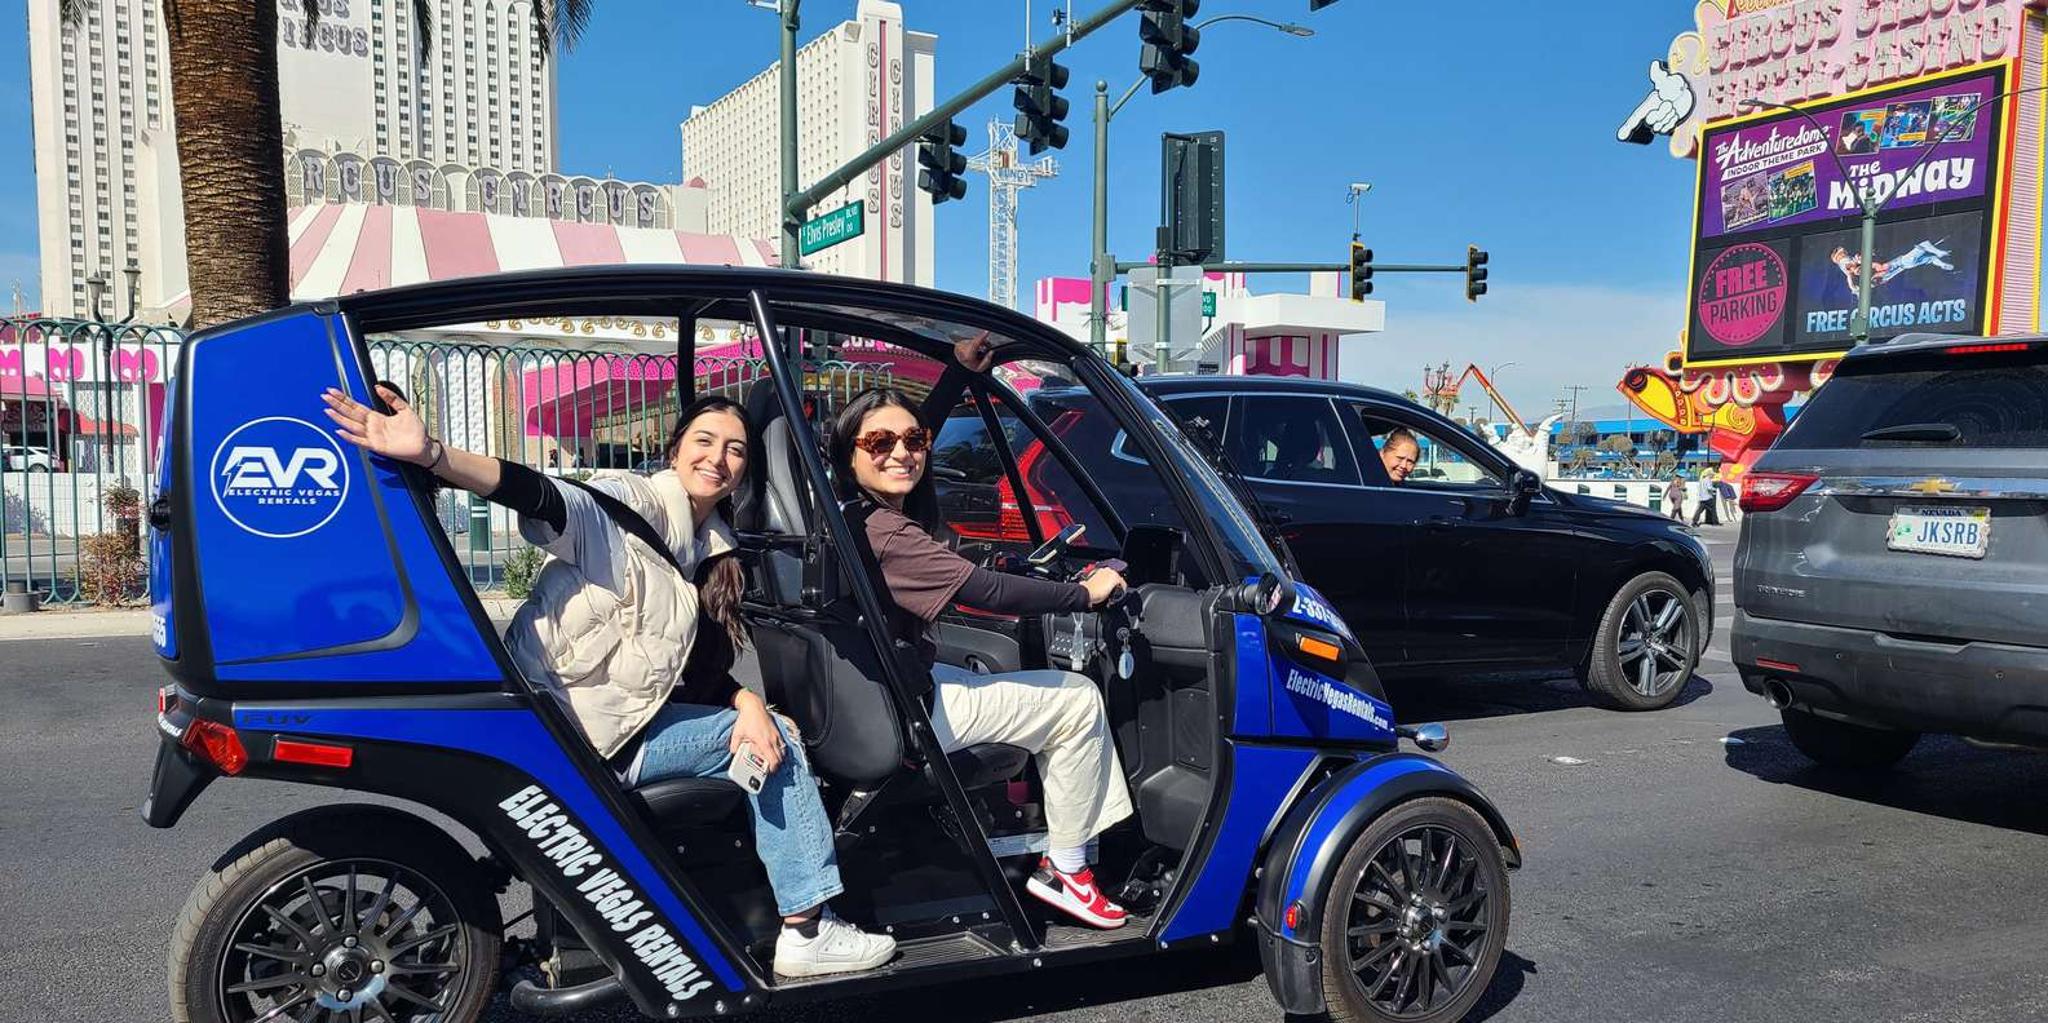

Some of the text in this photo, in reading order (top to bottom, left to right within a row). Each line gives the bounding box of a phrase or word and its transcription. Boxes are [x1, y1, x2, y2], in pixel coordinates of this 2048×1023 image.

[282, 16, 369, 57] IRCUS
[1846, 4, 2009, 92] CASINO
[867, 41, 880, 214] CIRCUS
[889, 57, 902, 229] CIRCUS
[1716, 124, 1830, 170] The Adventuredome
[1727, 143, 1823, 178] INDOOR THEME PARK
[303, 156, 655, 222] RCUS CIRCUS
[807, 220, 822, 246] Elvis
[822, 213, 845, 240] Presley
[845, 205, 858, 219] BLVD
[1715, 259, 1768, 298] FREE
[1710, 290, 1777, 325] PARKING
[1806, 299, 1966, 333] FREE RCUS ACTS
[220, 446, 340, 490] EVR
[228, 489, 341, 497] ELECTRIC VEGAS
[257, 497, 318, 506] RENTALS
[1921, 509, 1962, 517] NEVADA
[1916, 521, 1979, 545] JKSRB
[1286, 668, 1389, 730] ElectricVegasRentals.com
[498, 784, 714, 1000] ELECTRIC VEGAS RENTALS
